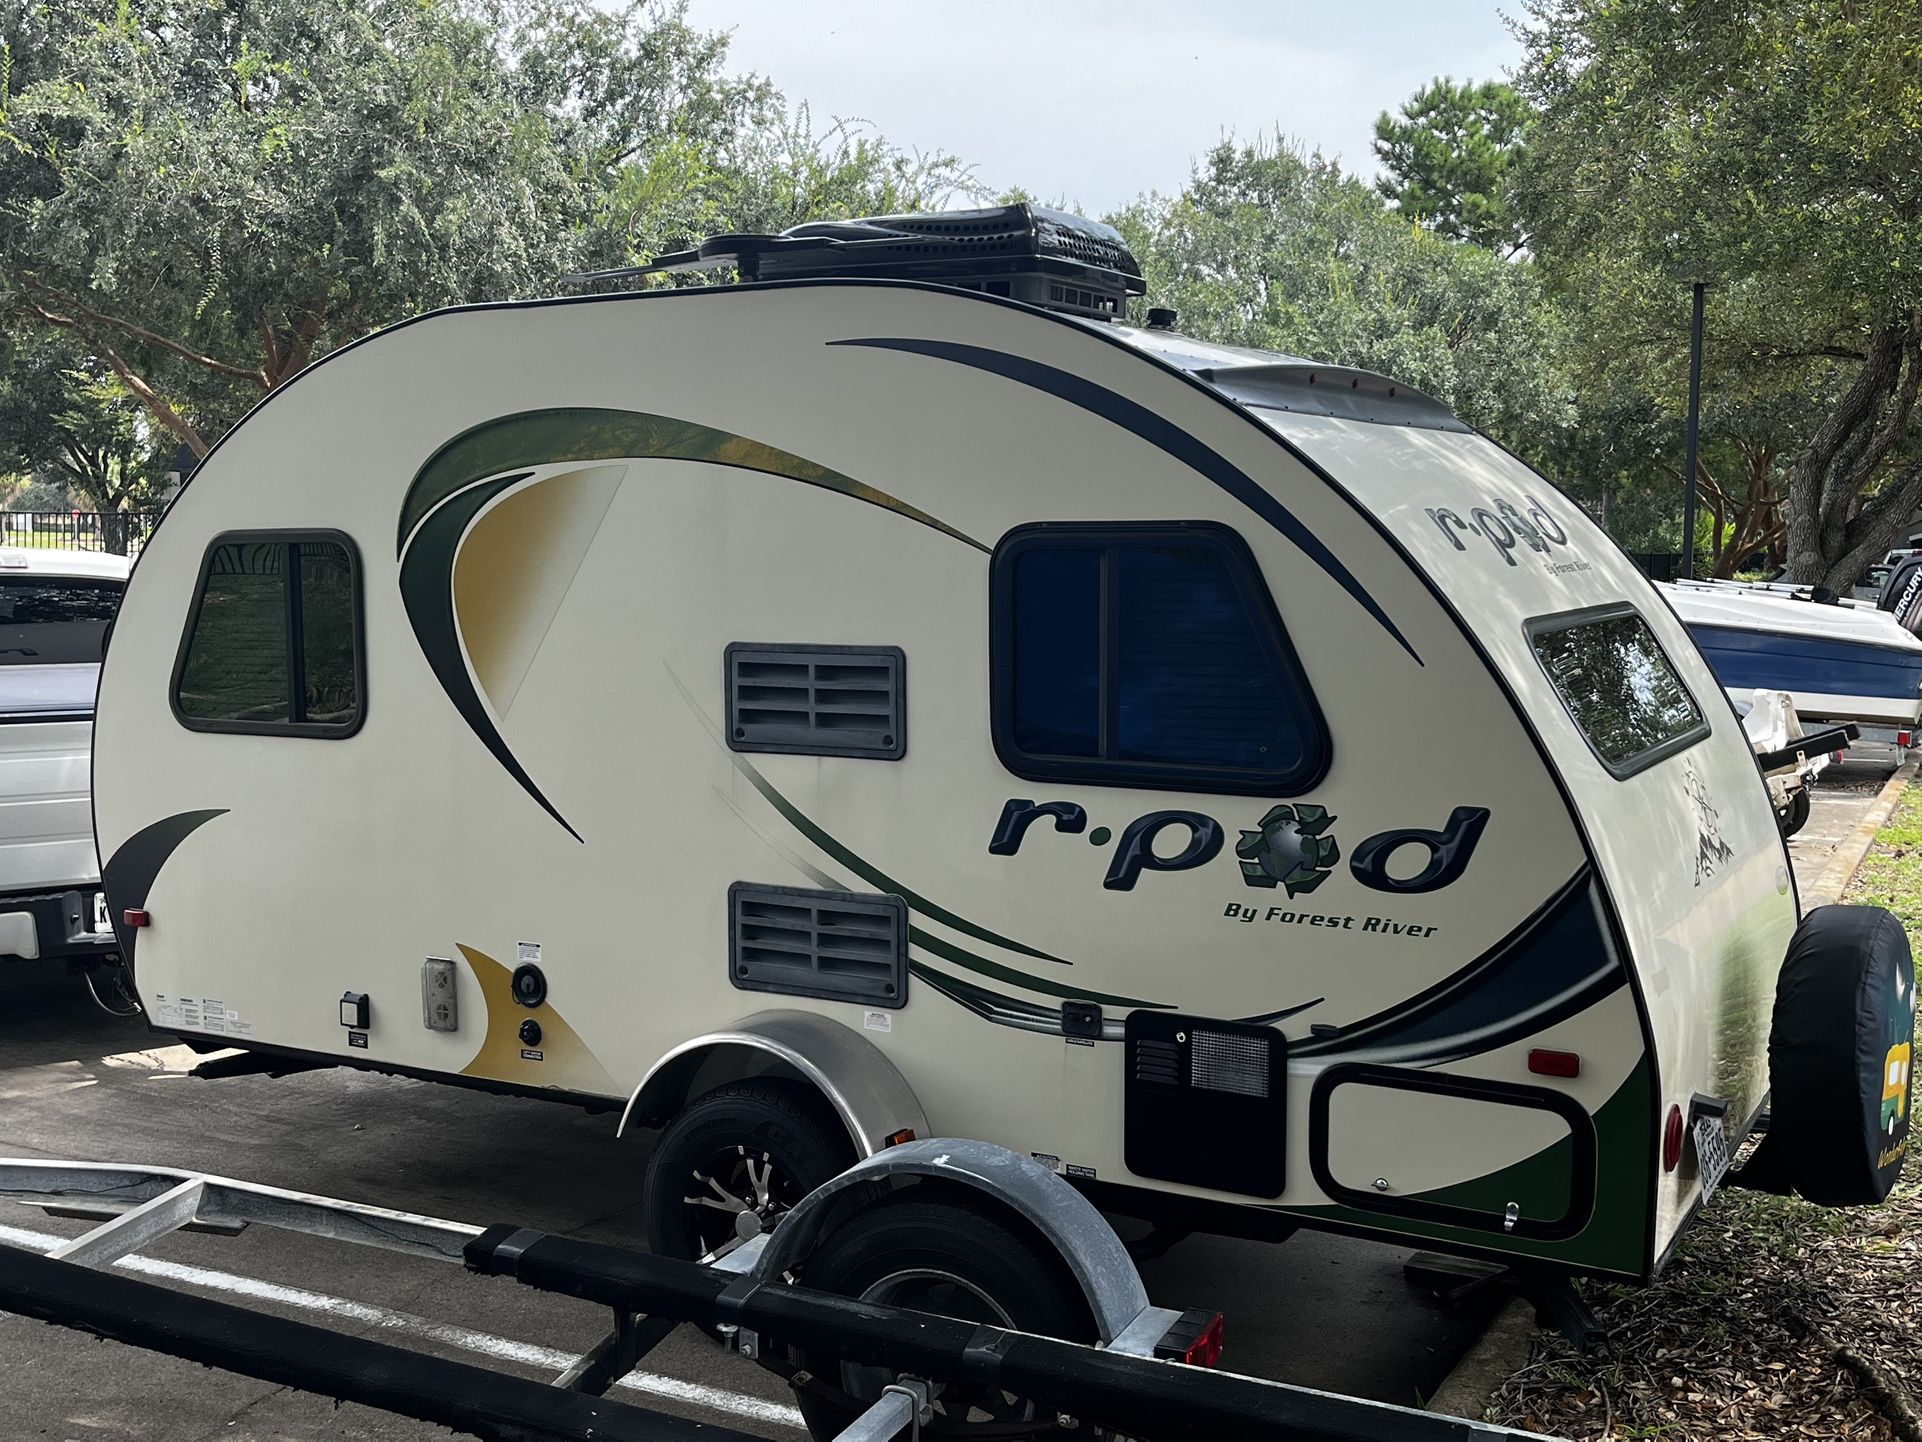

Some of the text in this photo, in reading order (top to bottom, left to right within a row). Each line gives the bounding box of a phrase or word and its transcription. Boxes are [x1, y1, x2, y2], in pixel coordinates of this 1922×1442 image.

[1223, 902, 1439, 938] By Forest River
